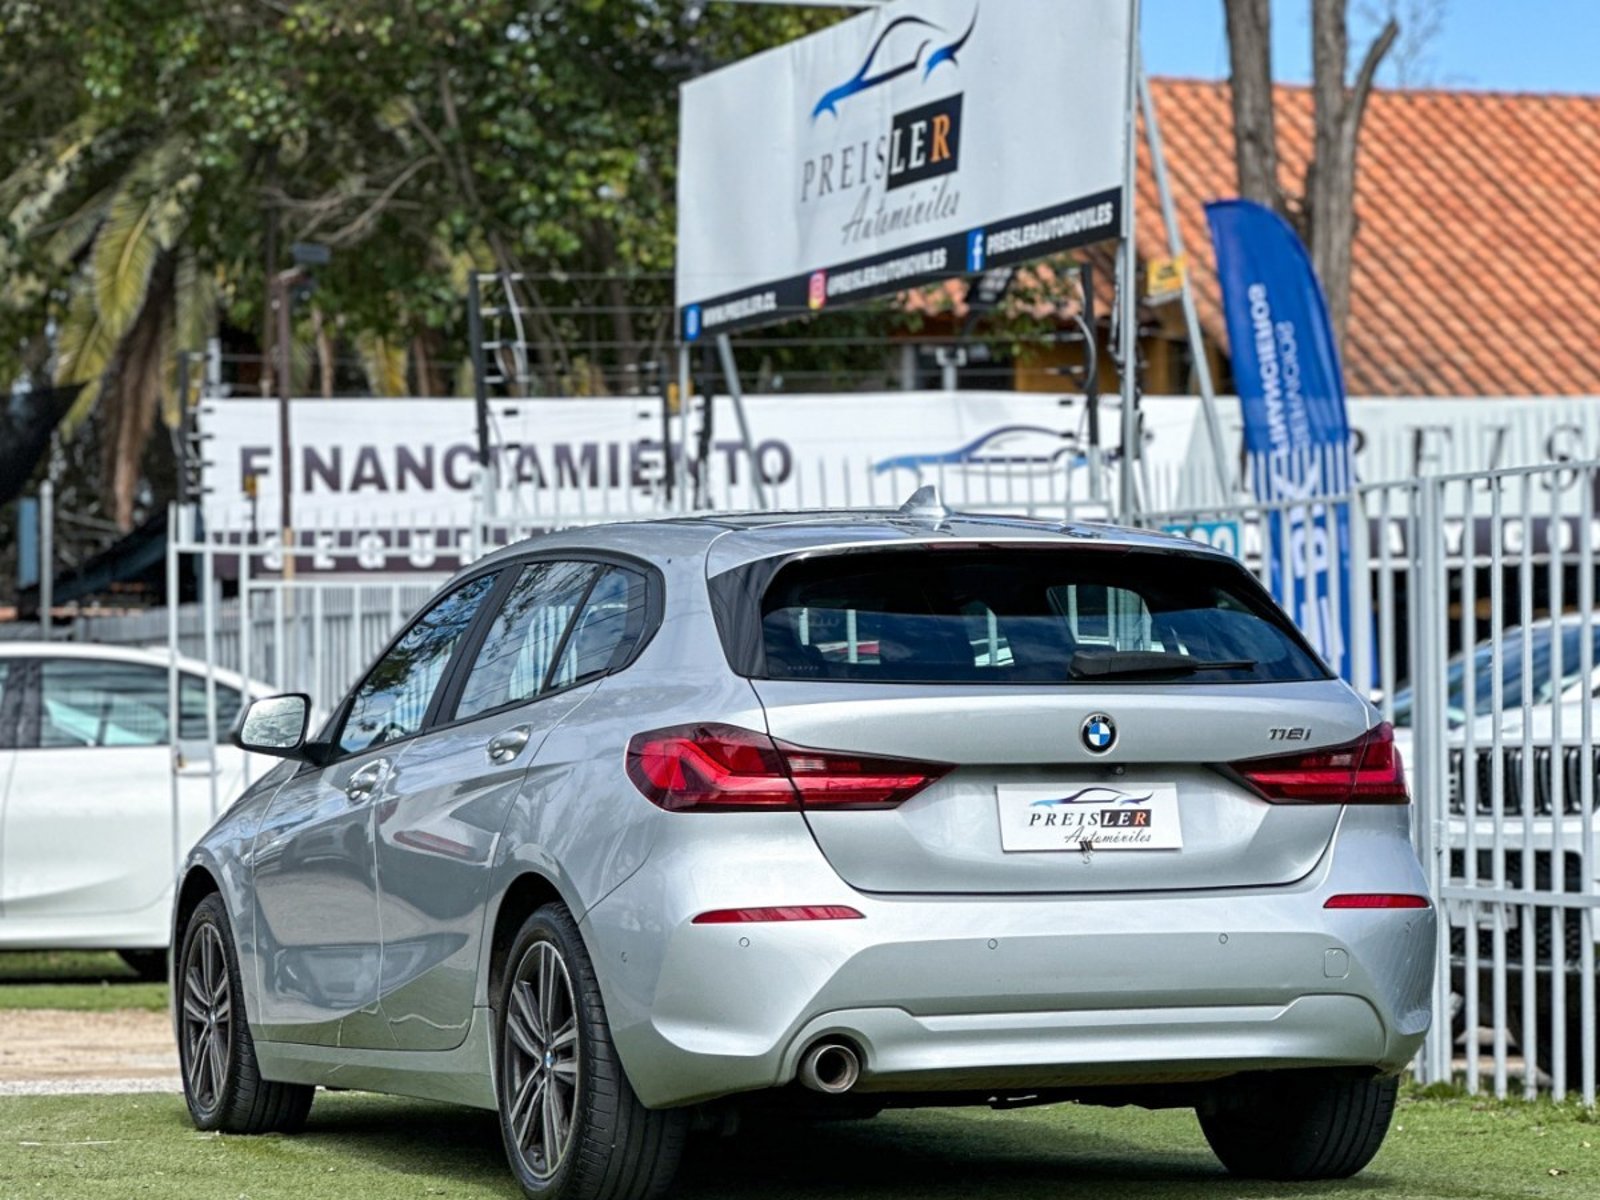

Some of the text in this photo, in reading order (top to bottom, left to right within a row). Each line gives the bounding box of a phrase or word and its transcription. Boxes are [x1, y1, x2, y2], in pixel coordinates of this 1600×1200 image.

[801, 114, 952, 203] PREISLER
[239, 439, 792, 493] FNANCIAMIETO
[1269, 728, 1312, 741] 118i
[1029, 810, 1147, 827] PREISLER
